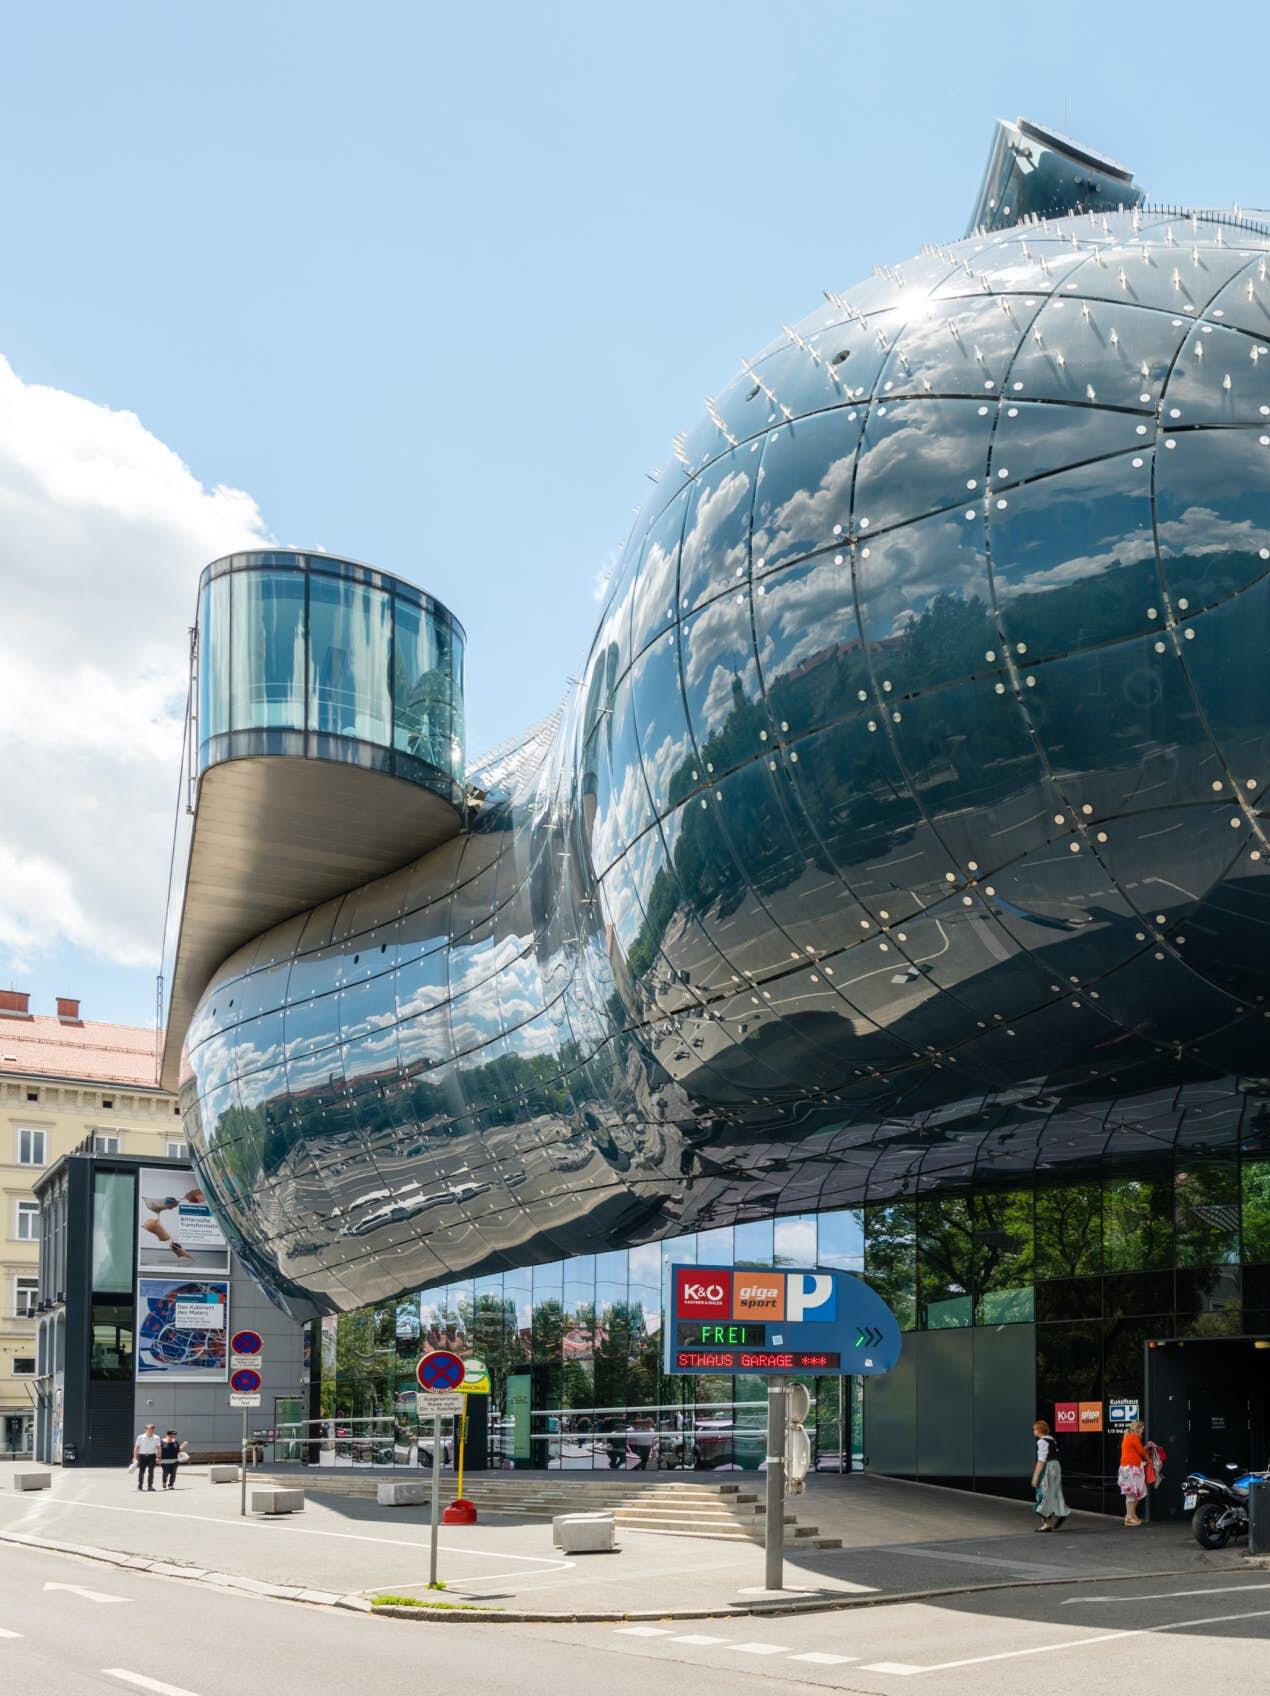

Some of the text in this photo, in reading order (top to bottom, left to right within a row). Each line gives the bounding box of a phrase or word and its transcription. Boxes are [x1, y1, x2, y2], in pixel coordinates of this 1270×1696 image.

[740, 1285, 778, 1299] giga
[787, 1273, 833, 1322] P
[740, 1299, 777, 1309] sport
[702, 1326, 746, 1344] FREI
[679, 1353, 733, 1366] STHAUS
[742, 1354, 793, 1367] GARAGE
